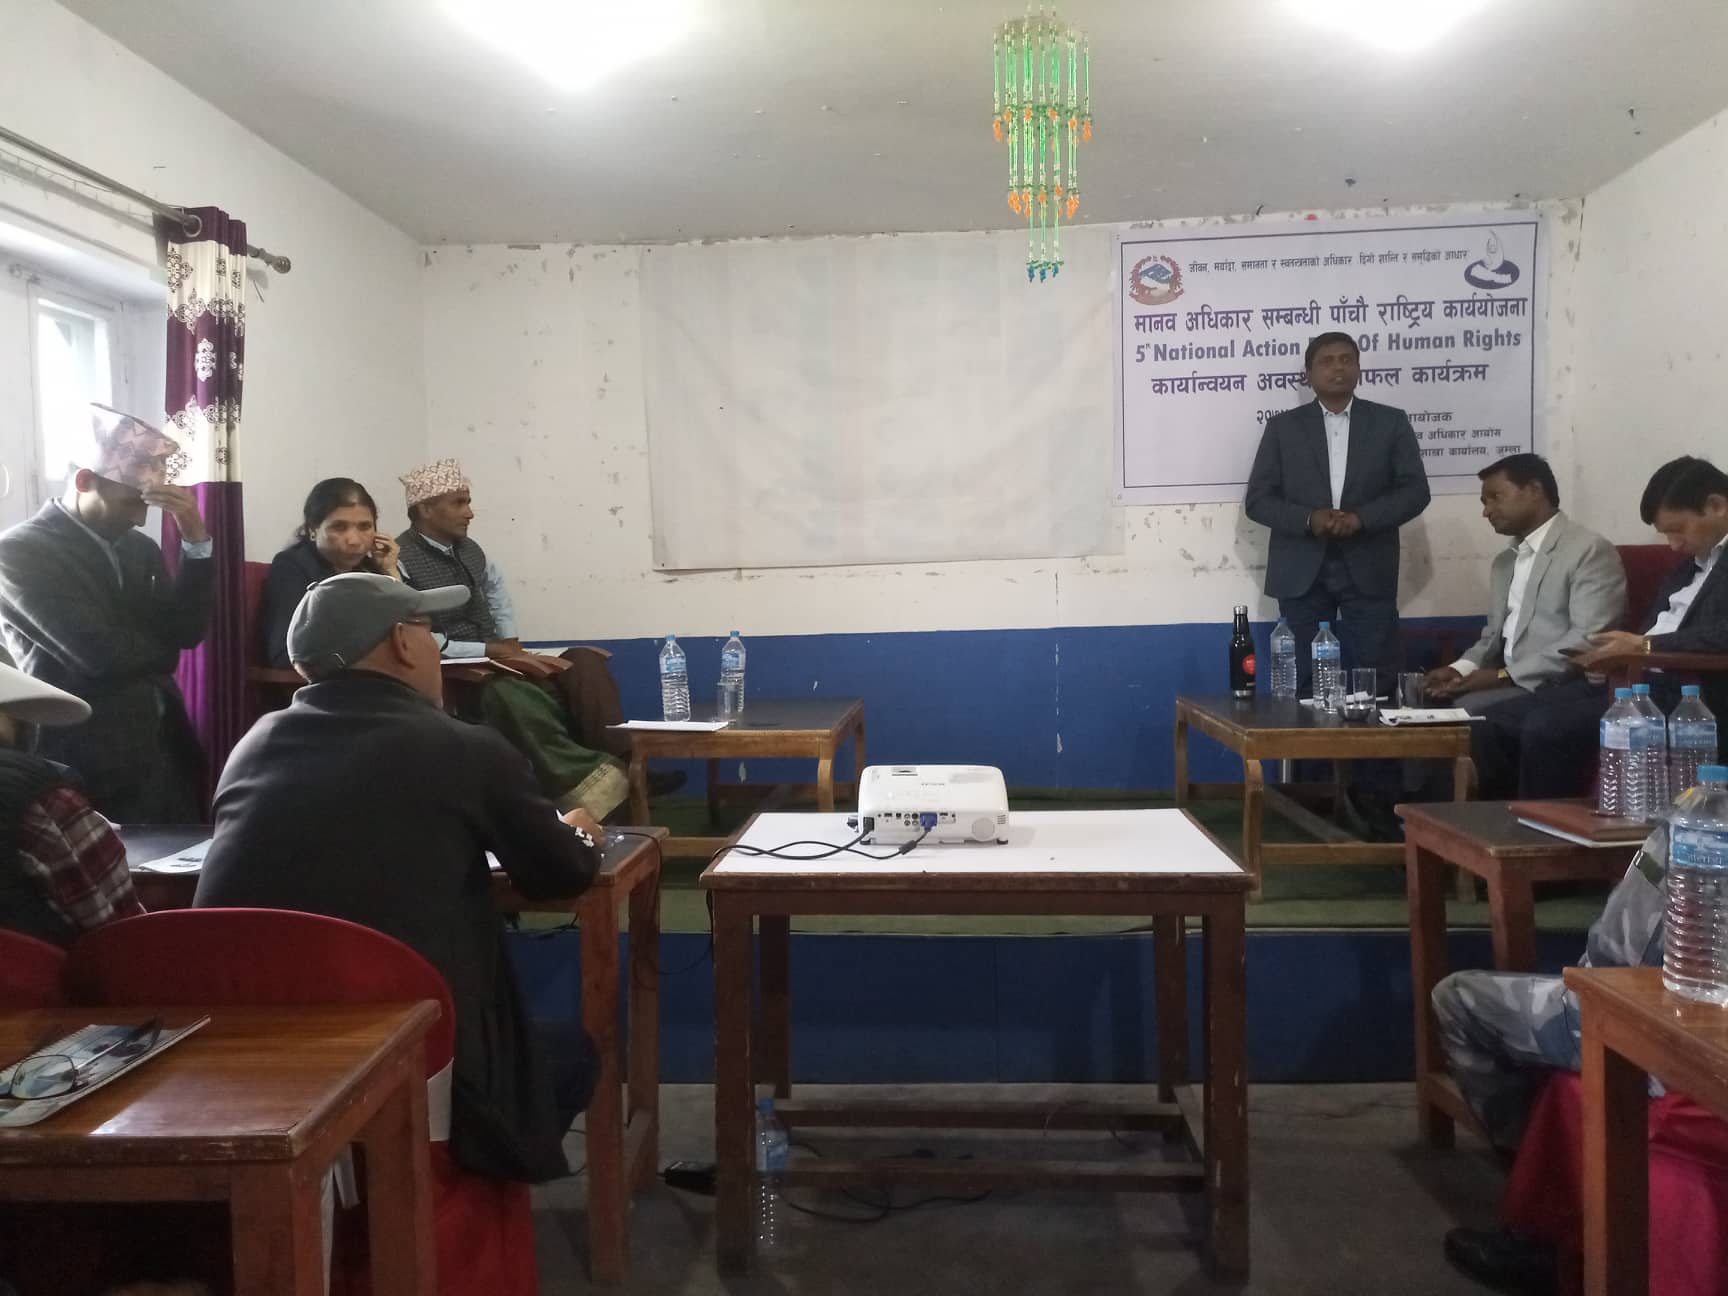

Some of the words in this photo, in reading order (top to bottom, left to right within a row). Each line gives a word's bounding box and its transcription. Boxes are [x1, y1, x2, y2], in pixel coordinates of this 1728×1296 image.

[1134, 313, 1177, 333] मानव
[1186, 304, 1253, 332] अधिकार
[1261, 300, 1321, 330] सम्बन्धी
[1377, 295, 1435, 328] राष्ट्रिय
[1443, 292, 1528, 319] कार्ययोजना
[1153, 340, 1234, 361] National
[1242, 338, 1300, 357] Action
[1358, 333, 1379, 353] Of
[1388, 332, 1455, 351] Human
[1463, 328, 1521, 350] Rights
[1151, 370, 1247, 395] कार्यान्वयन
[1412, 360, 1490, 384] कार्यक्रम
[1428, 428, 1467, 440] अधिकार
